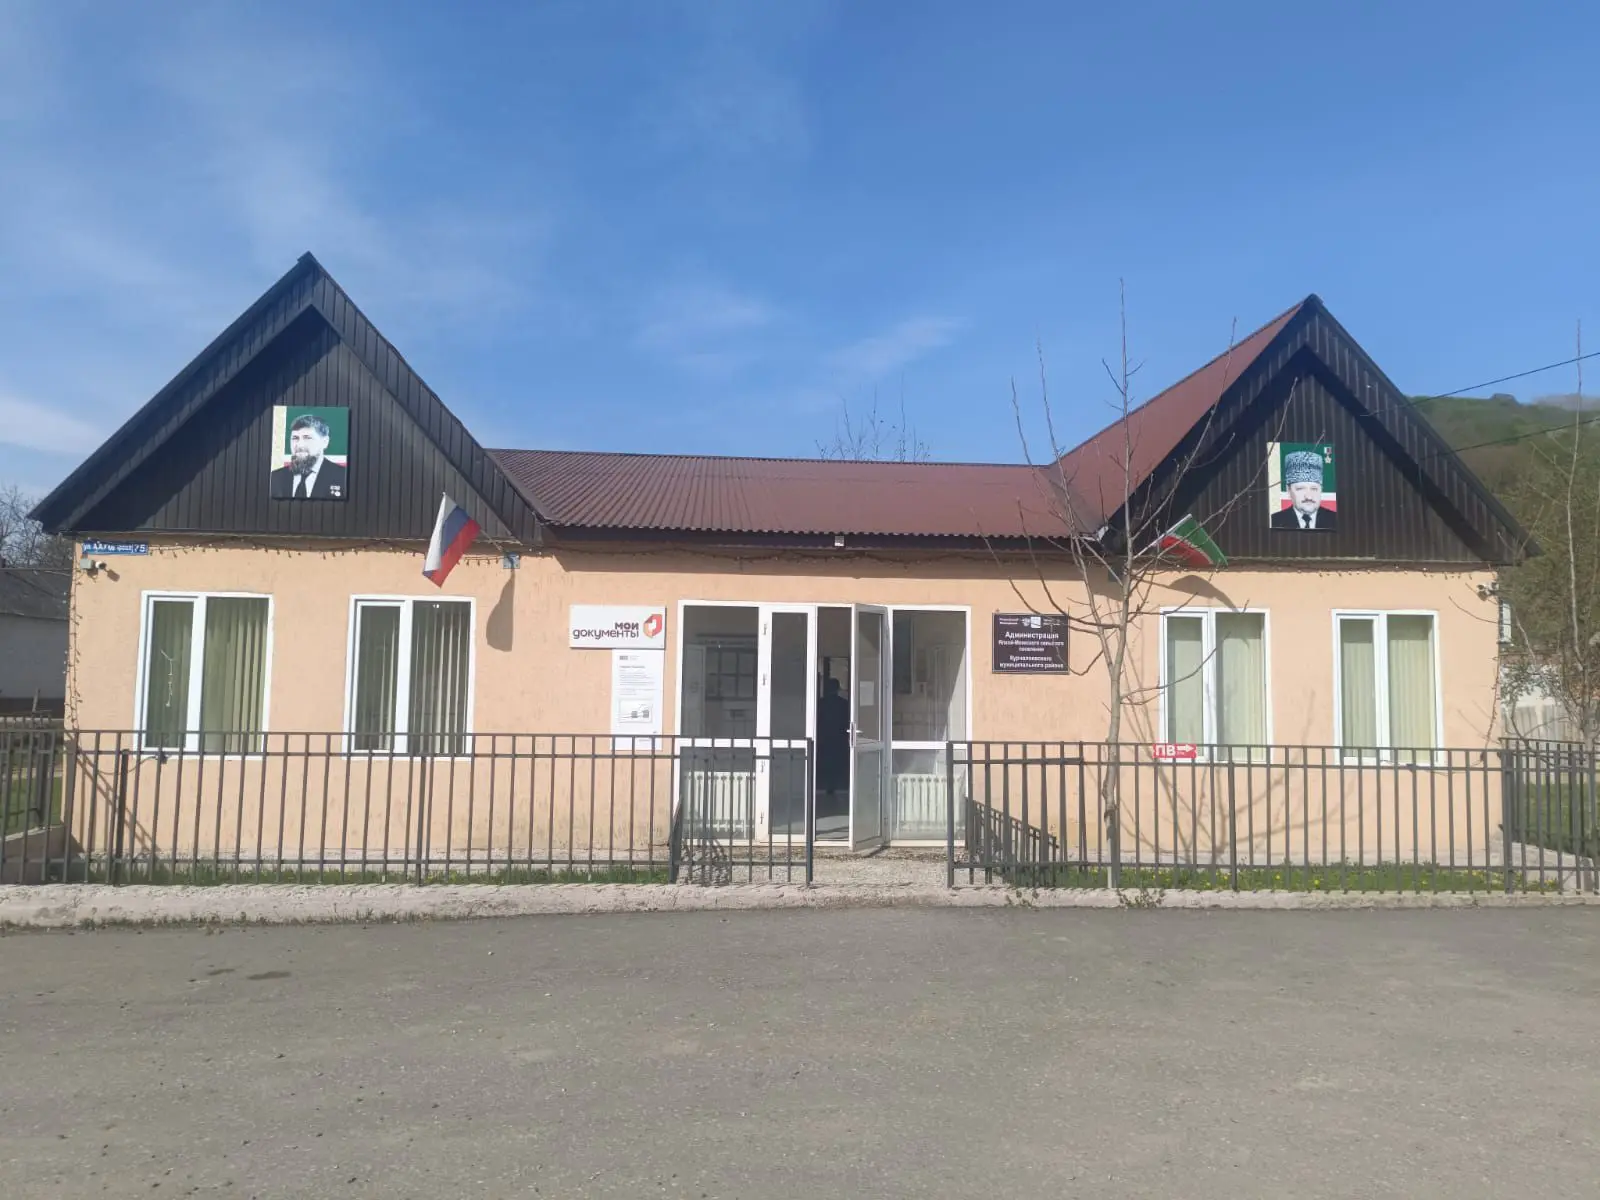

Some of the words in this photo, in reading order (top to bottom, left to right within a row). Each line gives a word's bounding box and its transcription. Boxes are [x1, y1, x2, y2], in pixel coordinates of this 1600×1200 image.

[615, 622, 639, 630] мои
[572, 629, 639, 640] документы
[1005, 631, 1059, 640] Администрация
[1155, 744, 1176, 757] ПВ
